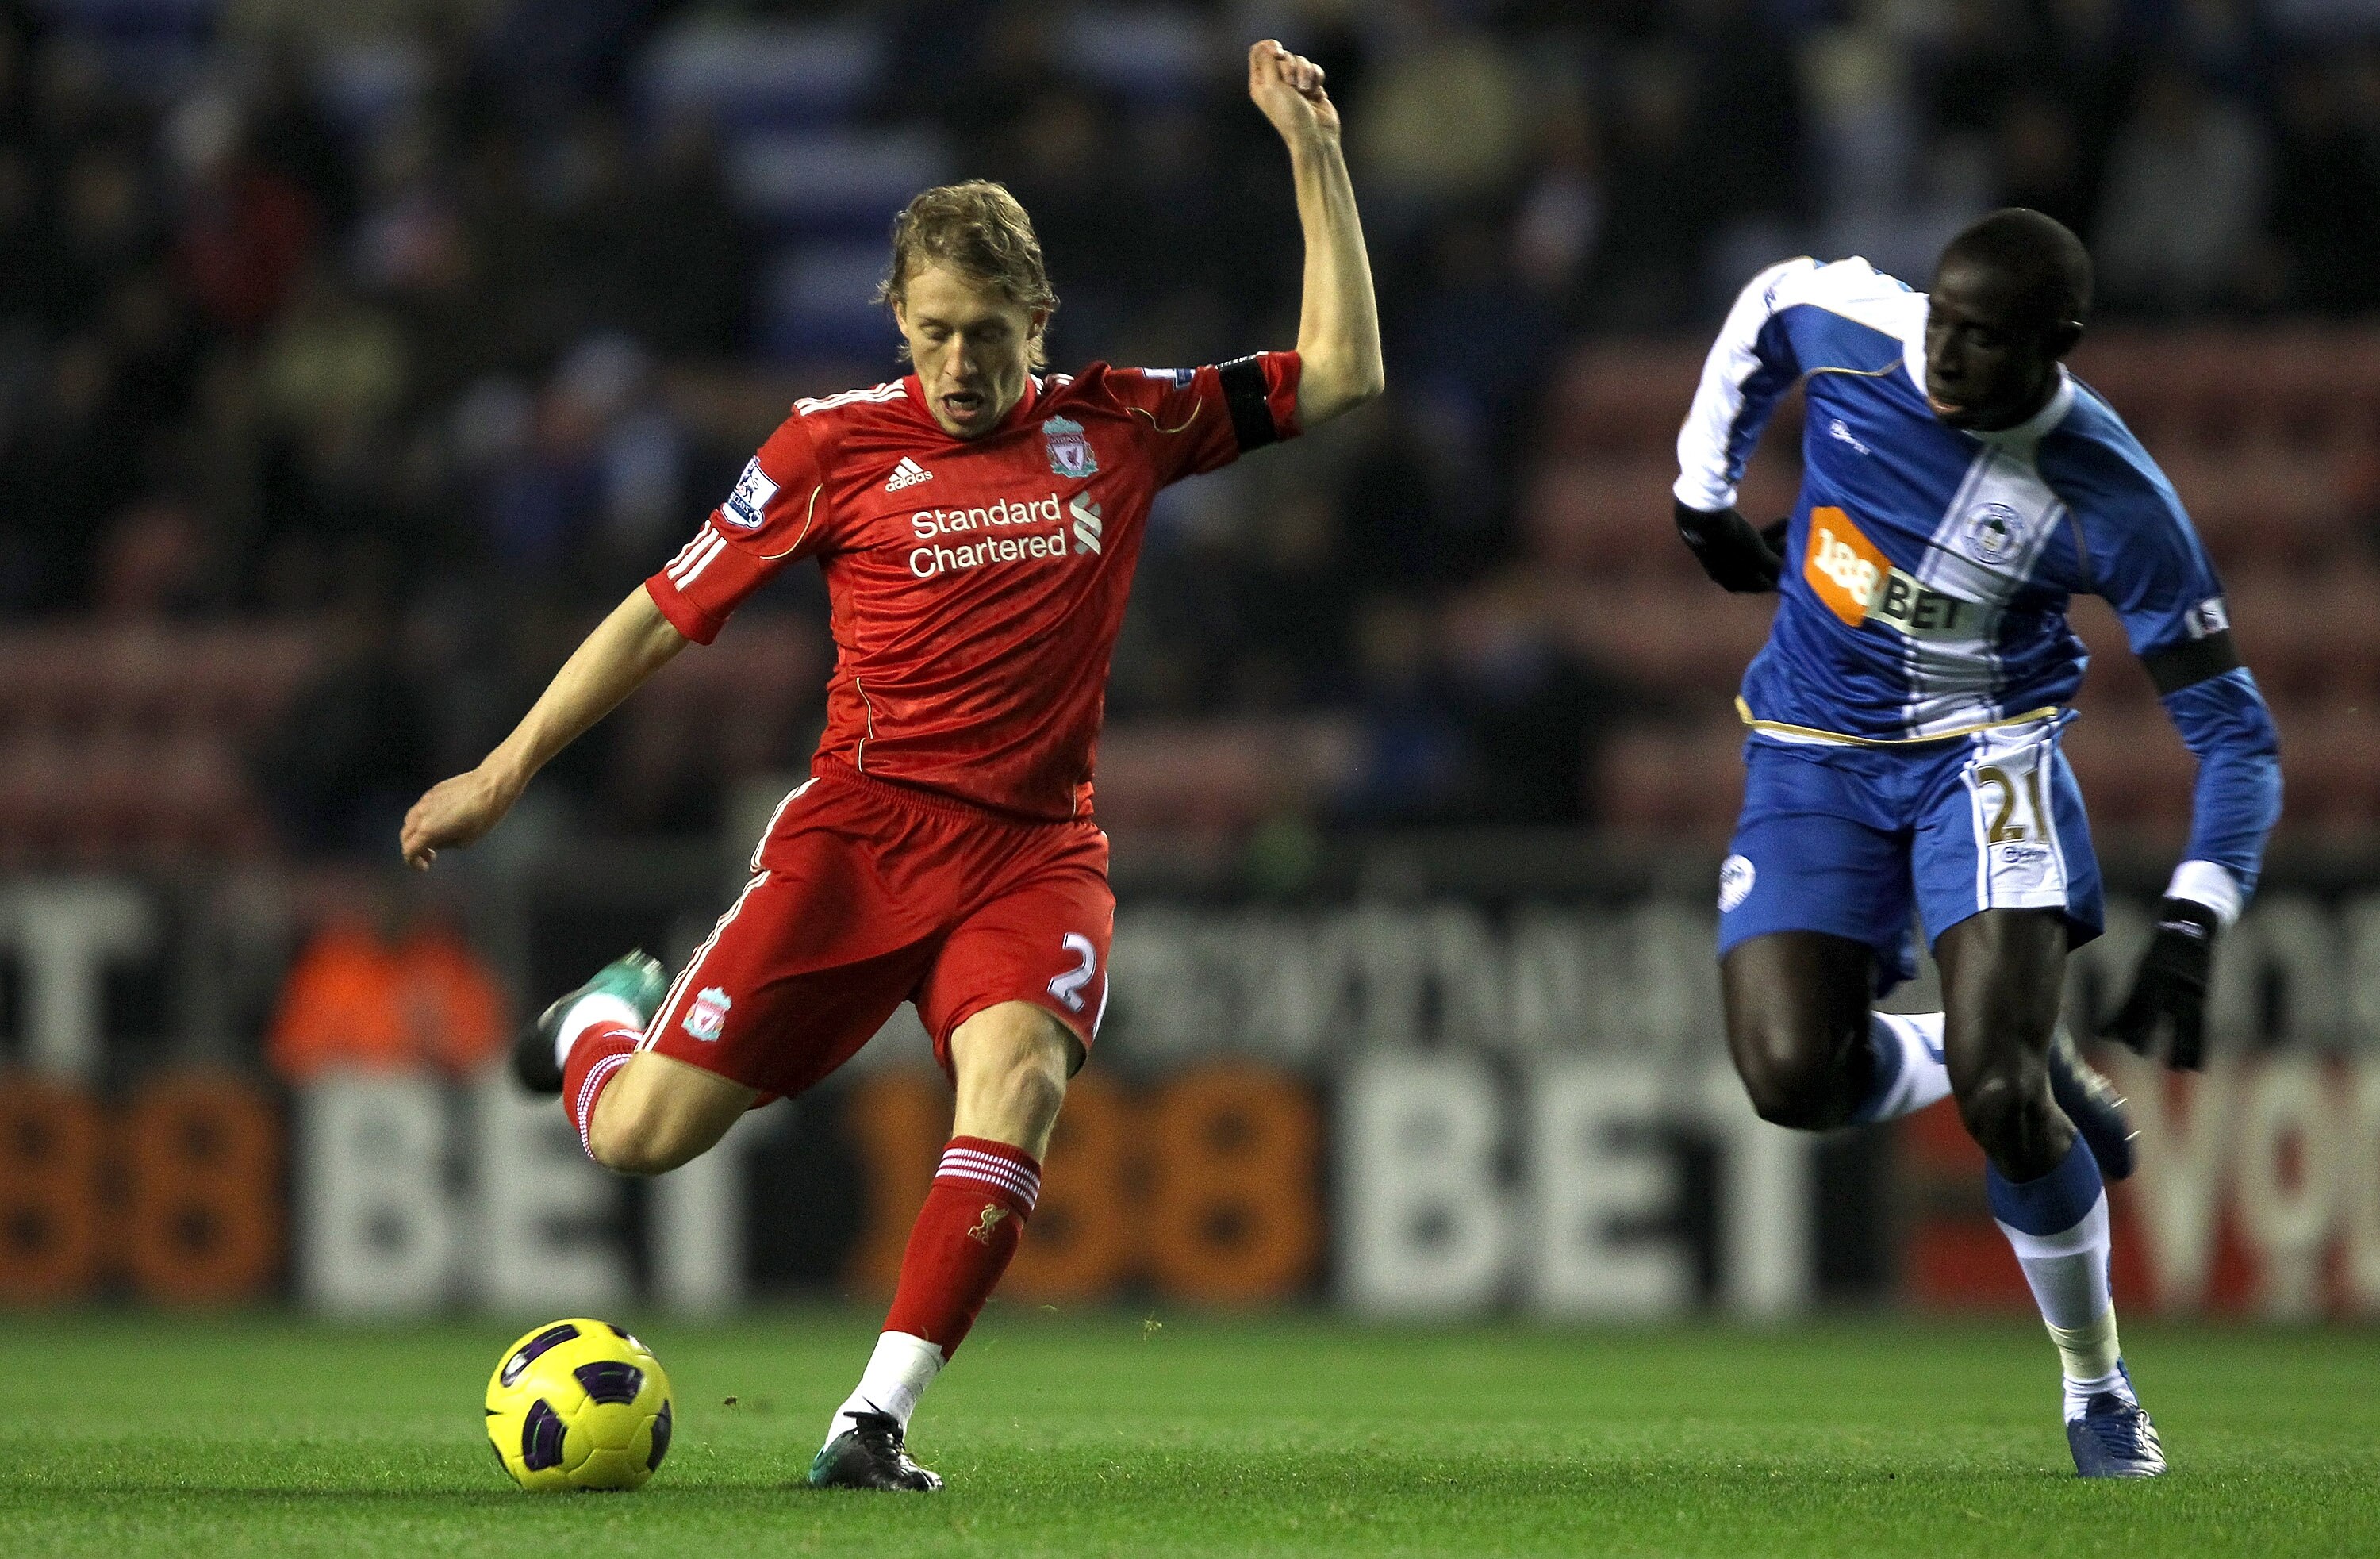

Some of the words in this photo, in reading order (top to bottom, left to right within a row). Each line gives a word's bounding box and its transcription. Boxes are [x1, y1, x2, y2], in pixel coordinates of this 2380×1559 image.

[885, 470, 934, 492] adidas
[912, 493, 1061, 540] Standard
[909, 528, 1068, 578] Chartered
[1976, 764, 2050, 846] 21
[1047, 931, 1096, 1013] 2
